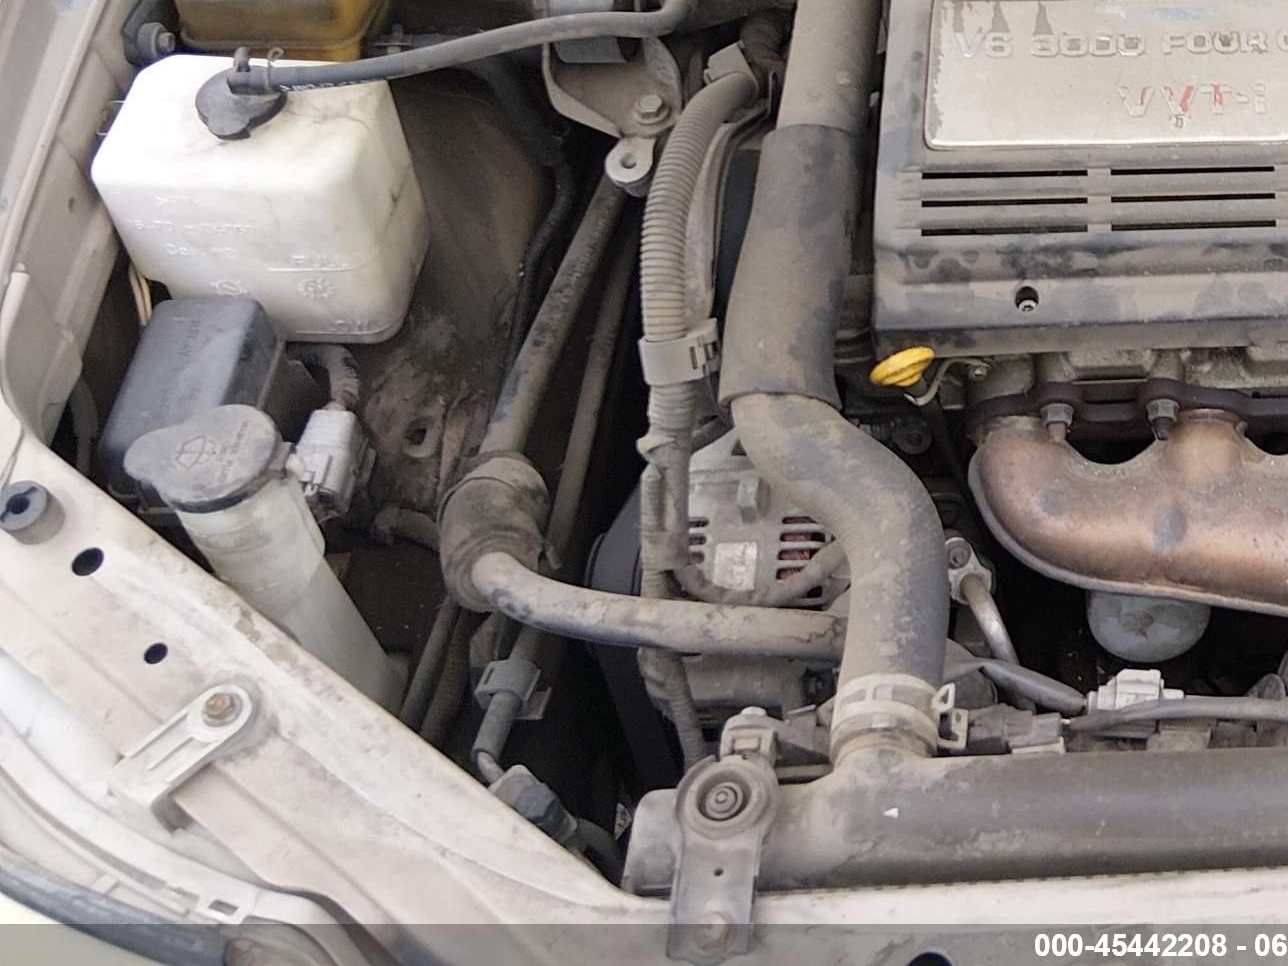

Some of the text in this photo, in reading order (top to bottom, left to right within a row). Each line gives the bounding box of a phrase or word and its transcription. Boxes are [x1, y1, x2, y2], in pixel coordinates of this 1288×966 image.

[954, 30, 1015, 58] V6
[1031, 33, 1144, 58] 3000
[1162, 30, 1268, 55] FOUR
[1118, 81, 1267, 118] VVT-i
